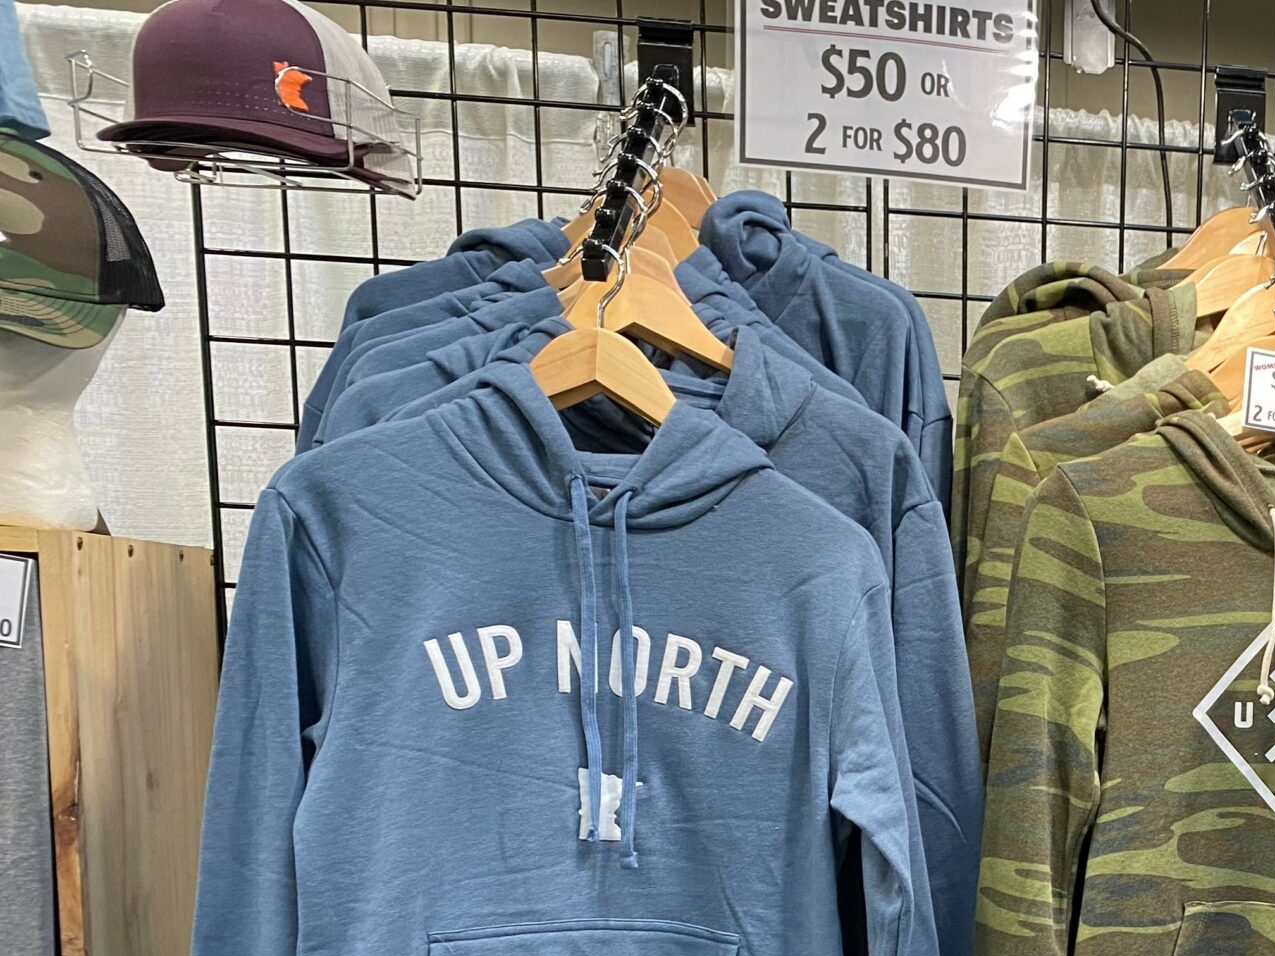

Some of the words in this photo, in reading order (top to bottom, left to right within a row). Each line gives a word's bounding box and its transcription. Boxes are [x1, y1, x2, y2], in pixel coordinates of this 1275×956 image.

[761, 0, 1014, 43] SWEATSHIRTS
[820, 44, 907, 102] $50
[921, 72, 949, 97] OR
[804, 112, 827, 155] 2
[842, 125, 882, 151] FOR
[893, 118, 966, 167] $80
[1253, 405, 1263, 422] 2
[423, 624, 523, 710] UP
[556, 619, 794, 743] NORTH
[1234, 702, 1254, 728] U
